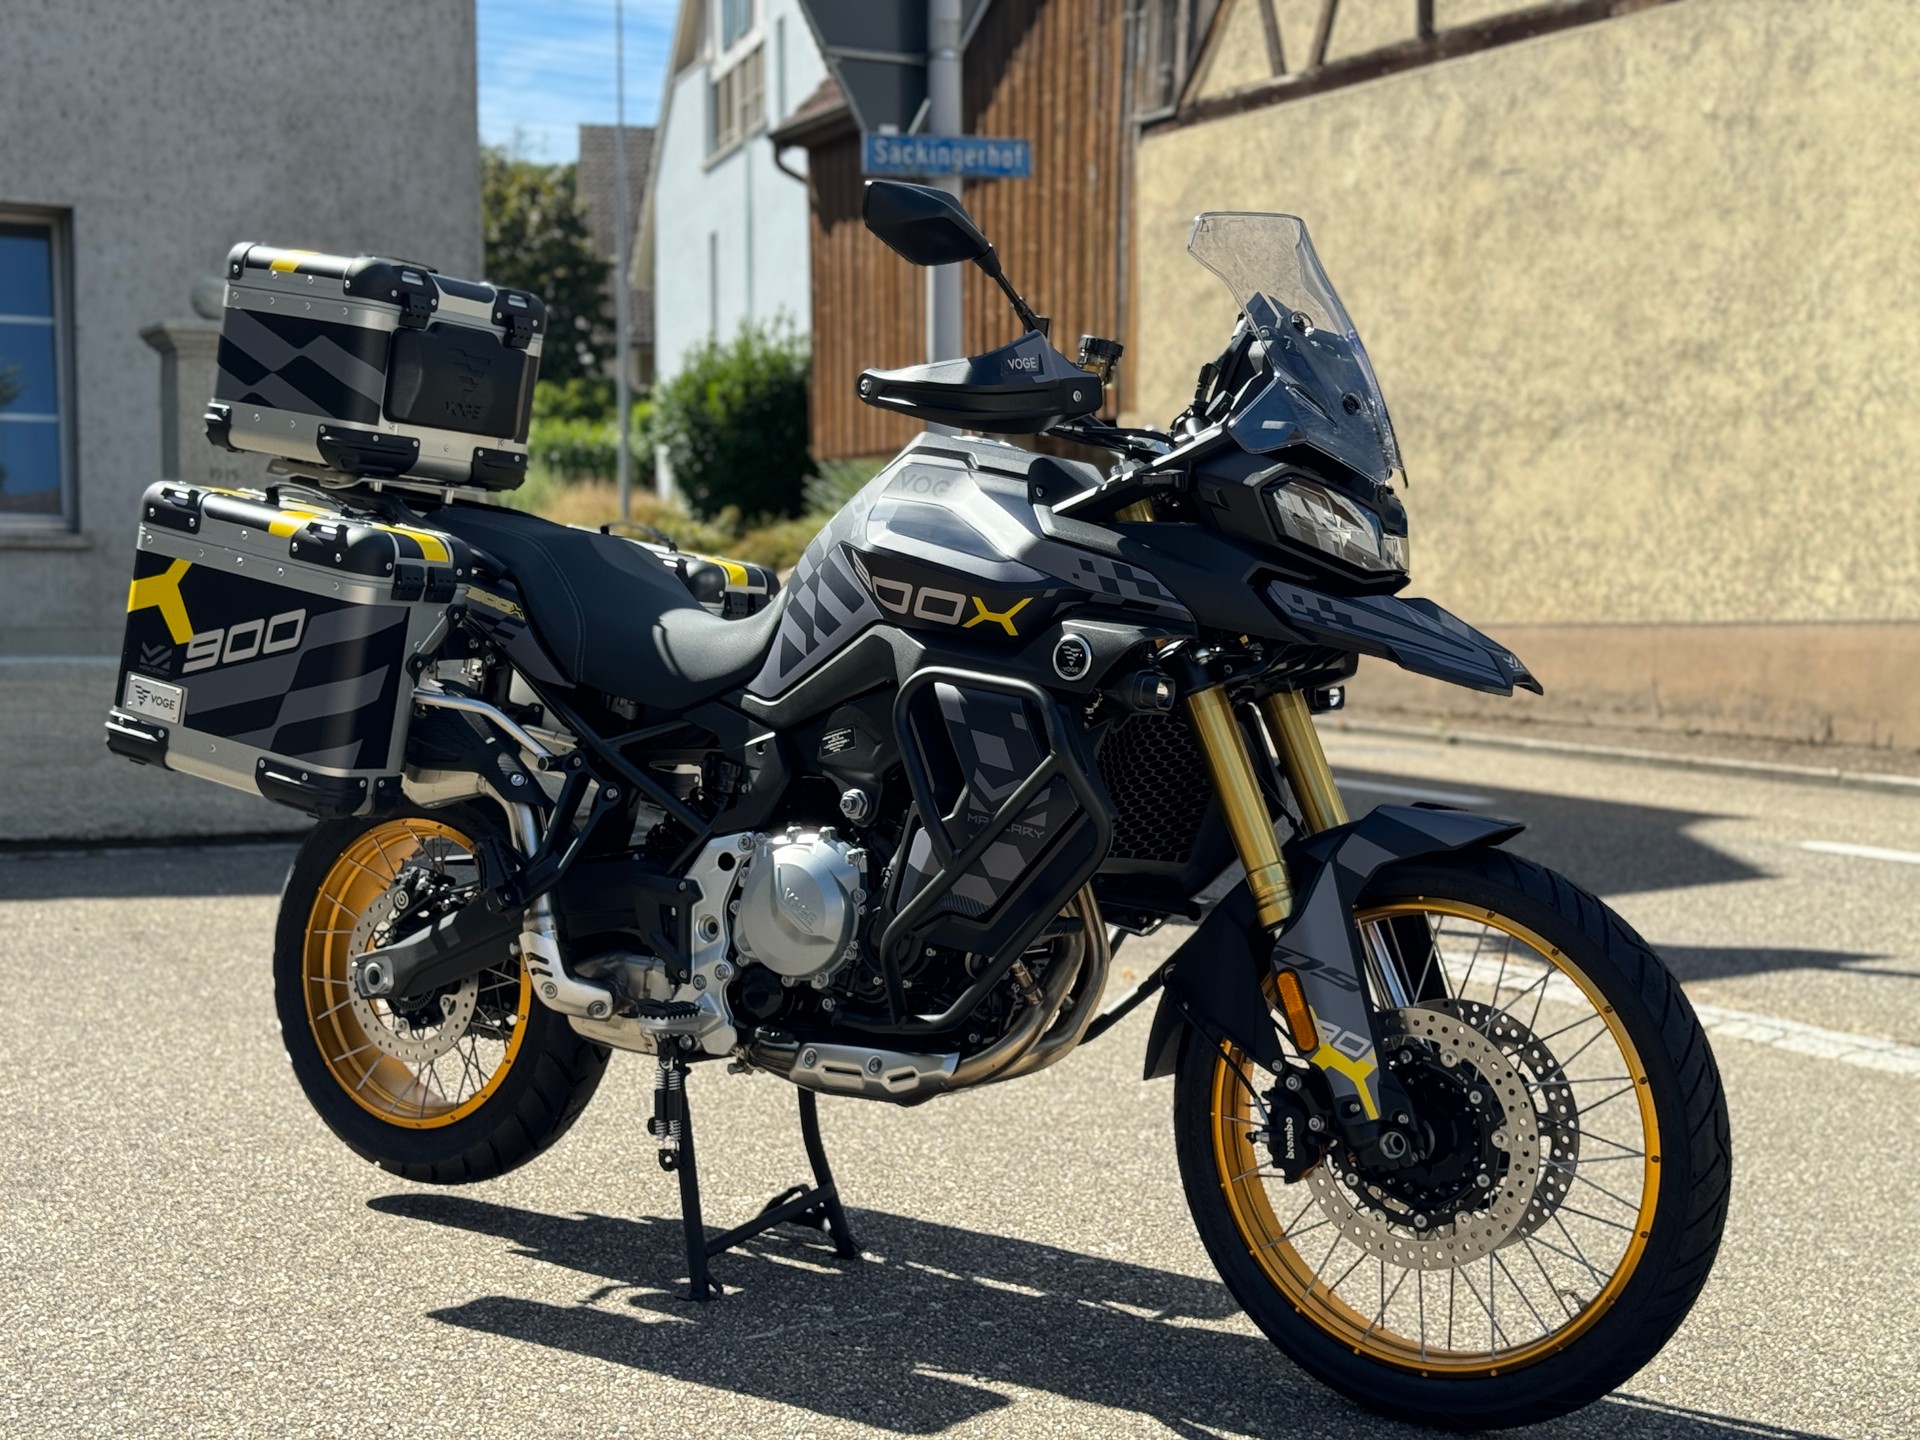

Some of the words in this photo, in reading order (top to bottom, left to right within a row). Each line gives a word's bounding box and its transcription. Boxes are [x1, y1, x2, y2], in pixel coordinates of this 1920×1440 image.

[1007, 357, 1037, 370] VOGE
[901, 470, 952, 497] VOG
[150, 693, 176, 711] VOGE
[1284, 1116, 1295, 1160] brembo
